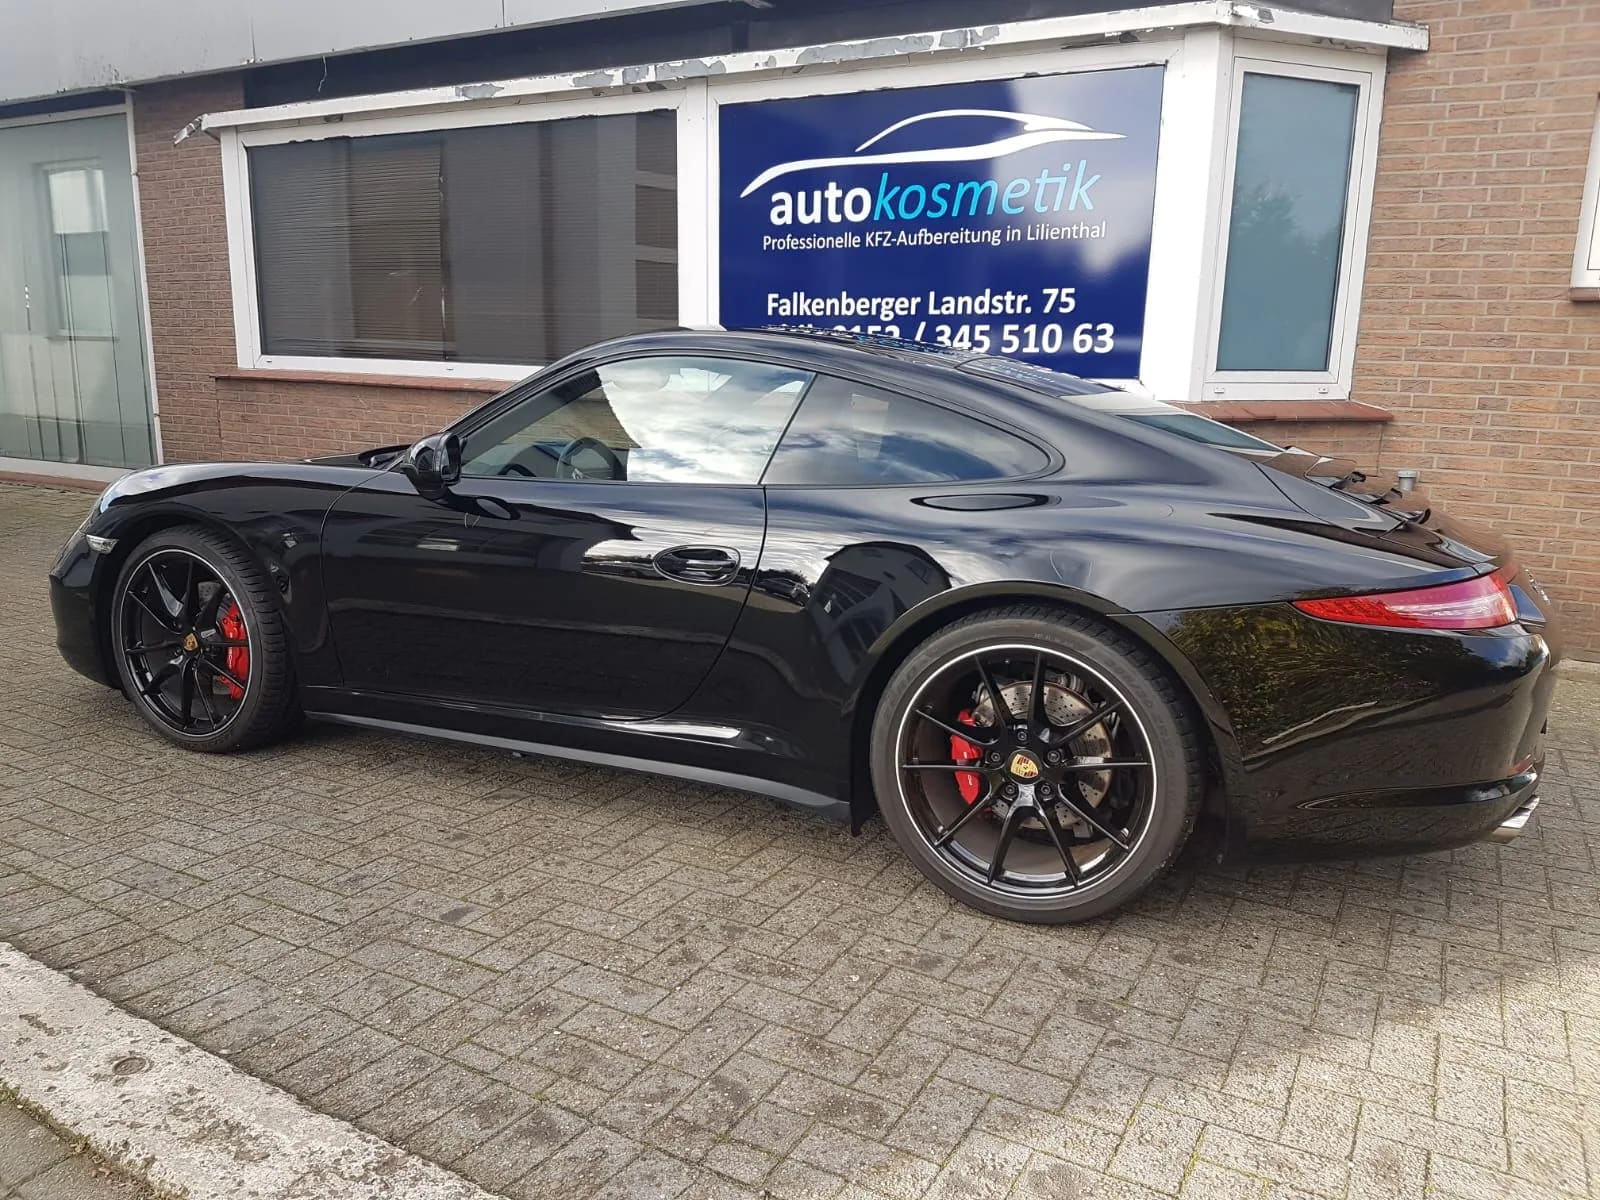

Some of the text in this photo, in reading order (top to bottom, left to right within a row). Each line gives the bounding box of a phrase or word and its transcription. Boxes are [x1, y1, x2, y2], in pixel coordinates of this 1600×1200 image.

[763, 221, 1106, 251] Professionelle KFZ-Aufbereitung in Lilienthal
[767, 287, 1076, 321] Falkenberger Landstr. 75
[935, 324, 991, 353] 345
[1000, 324, 1062, 353] 510
[1072, 322, 1115, 353] 63
